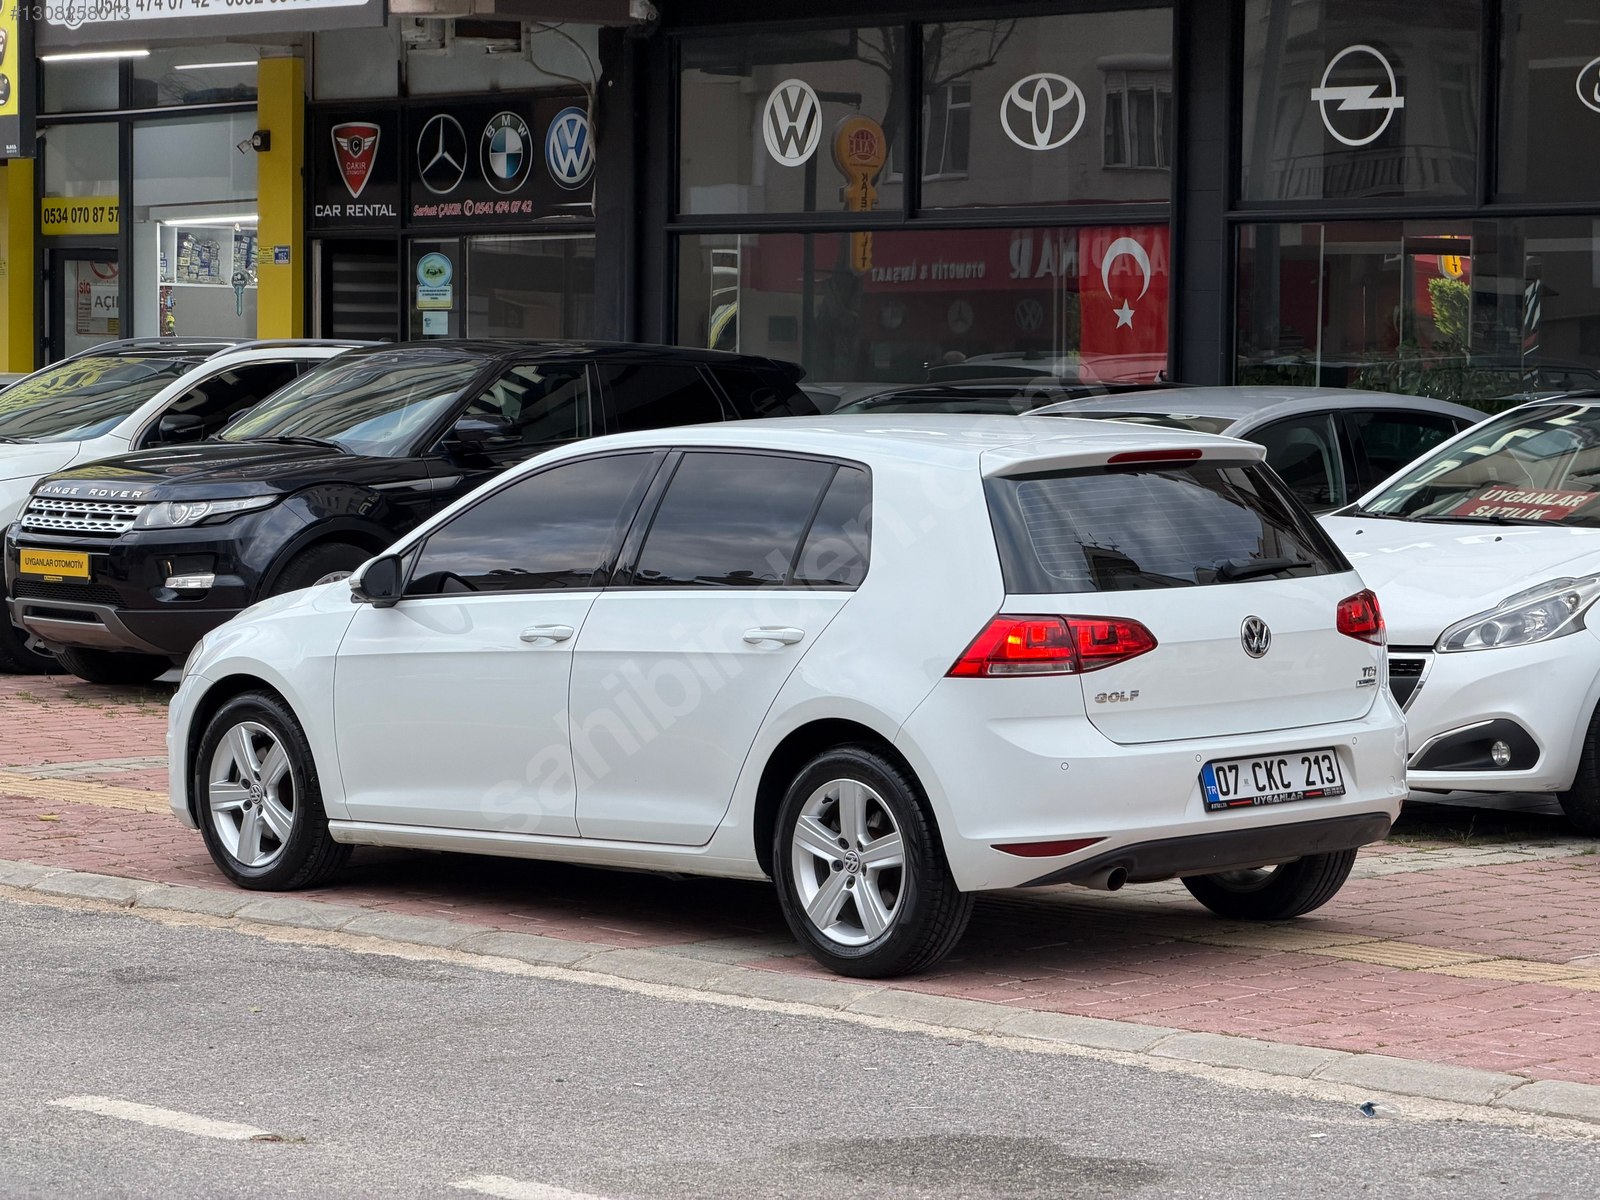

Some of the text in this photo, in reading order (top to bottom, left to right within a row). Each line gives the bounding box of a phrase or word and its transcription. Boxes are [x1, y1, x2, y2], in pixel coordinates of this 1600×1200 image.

[43, 206, 119, 224] 0534 070 87 57
[315, 204, 397, 217] CAR RENTAL
[37, 486, 143, 498] RANGE ROVER
[1478, 489, 1589, 507] UYGANLAR
[24, 557, 84, 570] UYGANLAR OTOMOTİV
[1094, 689, 1140, 704] GOLF
[1214, 754, 1337, 797] 07 CKC 213
[1206, 785, 1219, 796] TR
